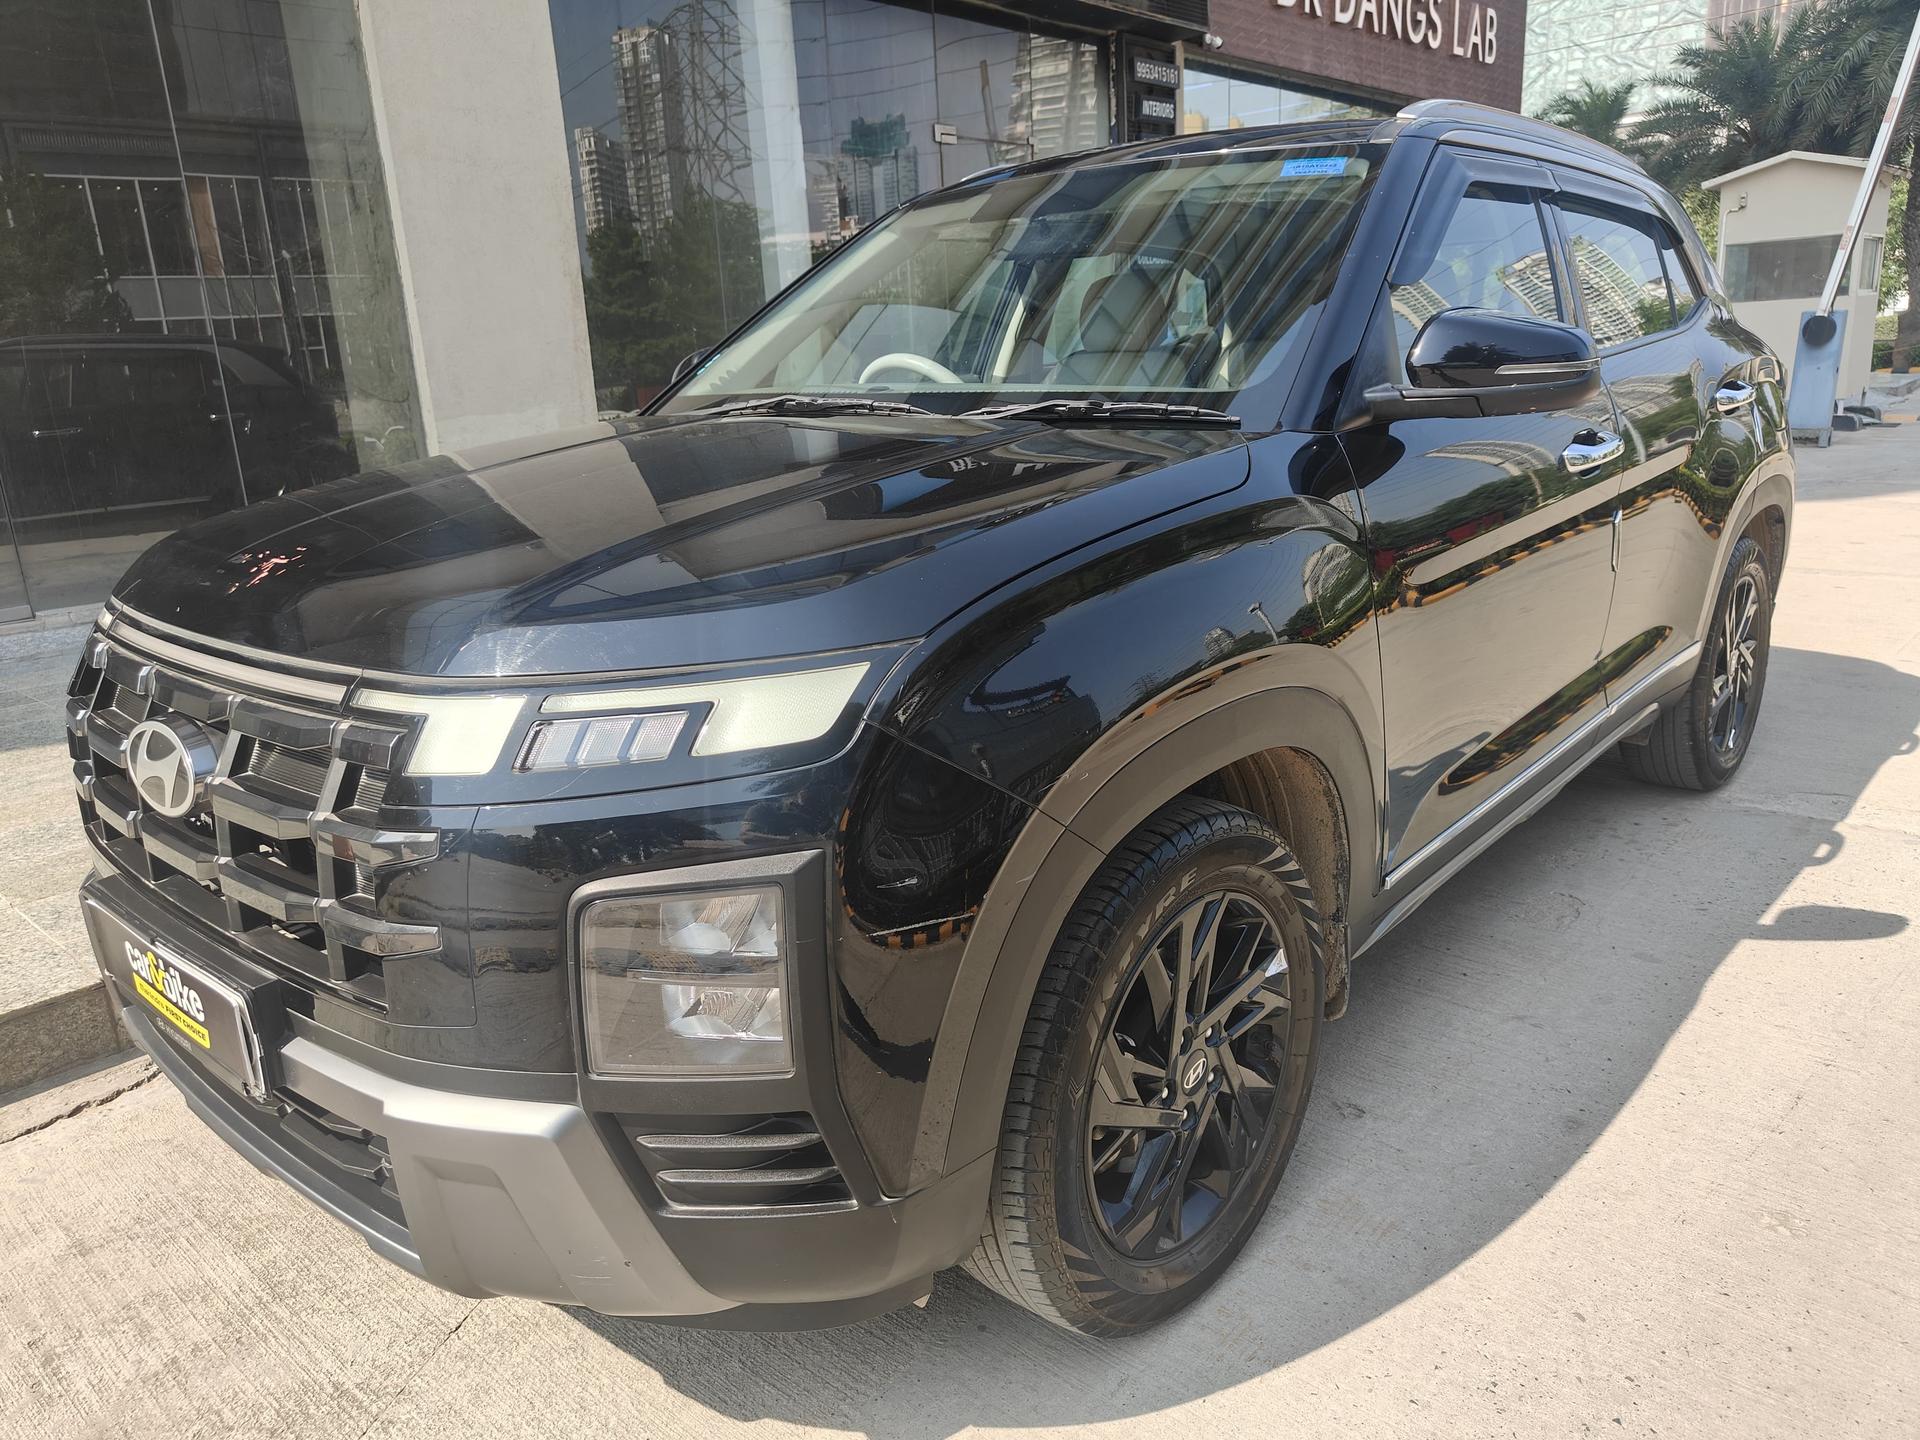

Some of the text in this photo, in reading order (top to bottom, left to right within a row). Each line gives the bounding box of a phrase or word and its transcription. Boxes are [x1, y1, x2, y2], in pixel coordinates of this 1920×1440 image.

[1452, 0, 1498, 65] LAB
[1142, 99, 1175, 119] INTERIORS
[181, 1018, 207, 1042] CHOICE
